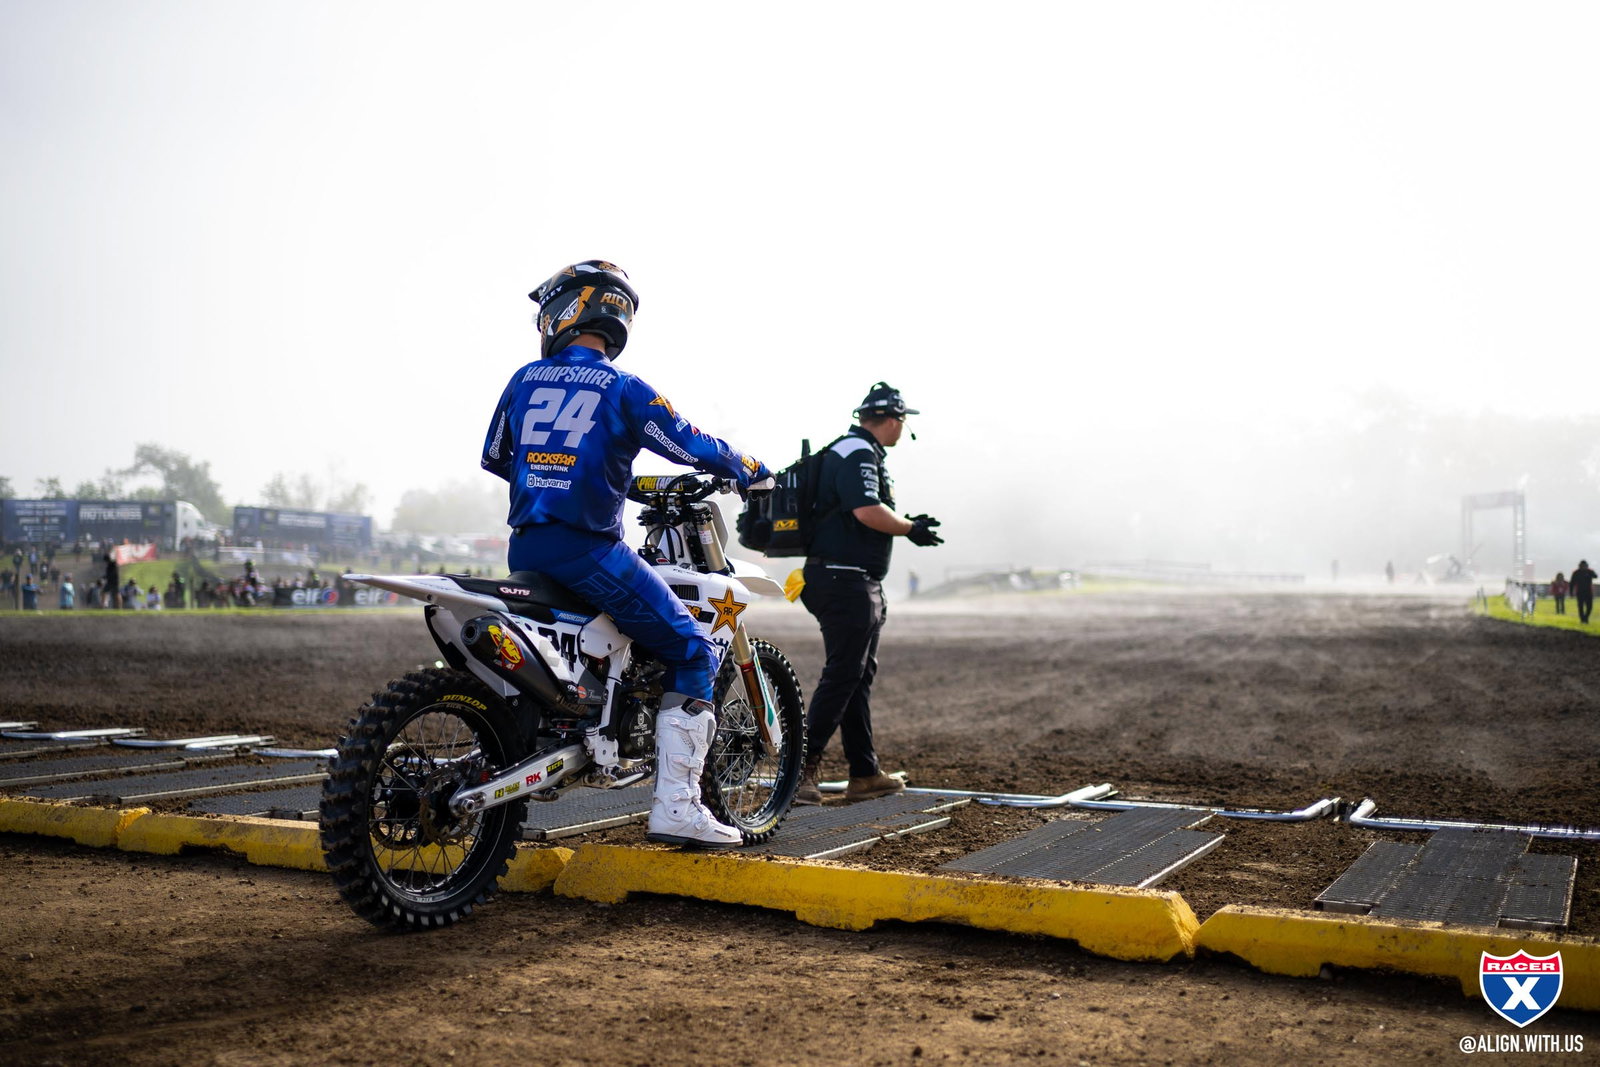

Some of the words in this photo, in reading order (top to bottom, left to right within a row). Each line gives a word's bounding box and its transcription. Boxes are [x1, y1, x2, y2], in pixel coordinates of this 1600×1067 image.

[522, 366, 616, 389] HAMPSHIRE
[520, 387, 601, 449] 24
[653, 427, 698, 463] Husqvarna
[530, 464, 553, 472] ENERGY
[553, 465, 569, 473] RINK
[291, 588, 320, 605] elf
[354, 589, 380, 605] elf
[500, 587, 530, 596] GUTS
[442, 694, 487, 711] DUNLOP
[525, 771, 542, 786] RK
